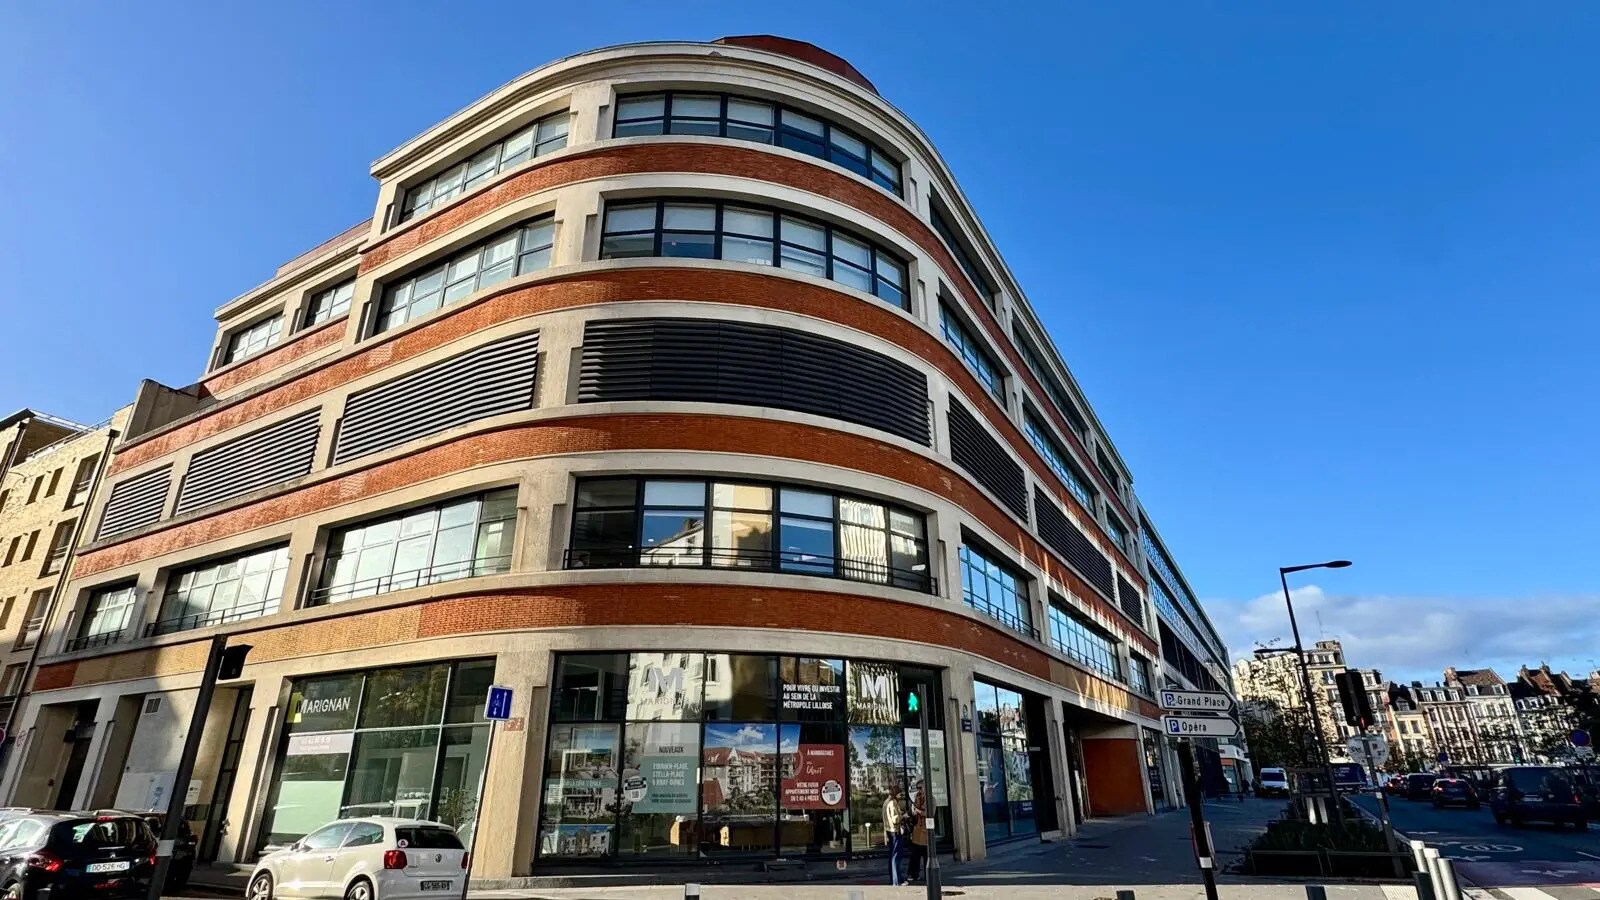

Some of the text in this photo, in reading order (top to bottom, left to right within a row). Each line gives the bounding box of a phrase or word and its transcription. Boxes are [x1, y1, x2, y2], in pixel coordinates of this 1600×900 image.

[783, 684, 797, 692] POUR
[797, 684, 811, 692] VIVRE
[812, 685, 819, 693] OU
[783, 692, 791, 700] AU
[791, 692, 802, 700] SEIN
[810, 693, 817, 701] LA
[1178, 695, 1201, 705] Grand
[1205, 697, 1225, 707] Place
[300, 697, 351, 714] MARIGNAN
[783, 699, 833, 710] MÉTROPOLE LILLOISE
[1182, 721, 1207, 733] Opéra
[659, 745, 684, 754] NOUVEAUX
